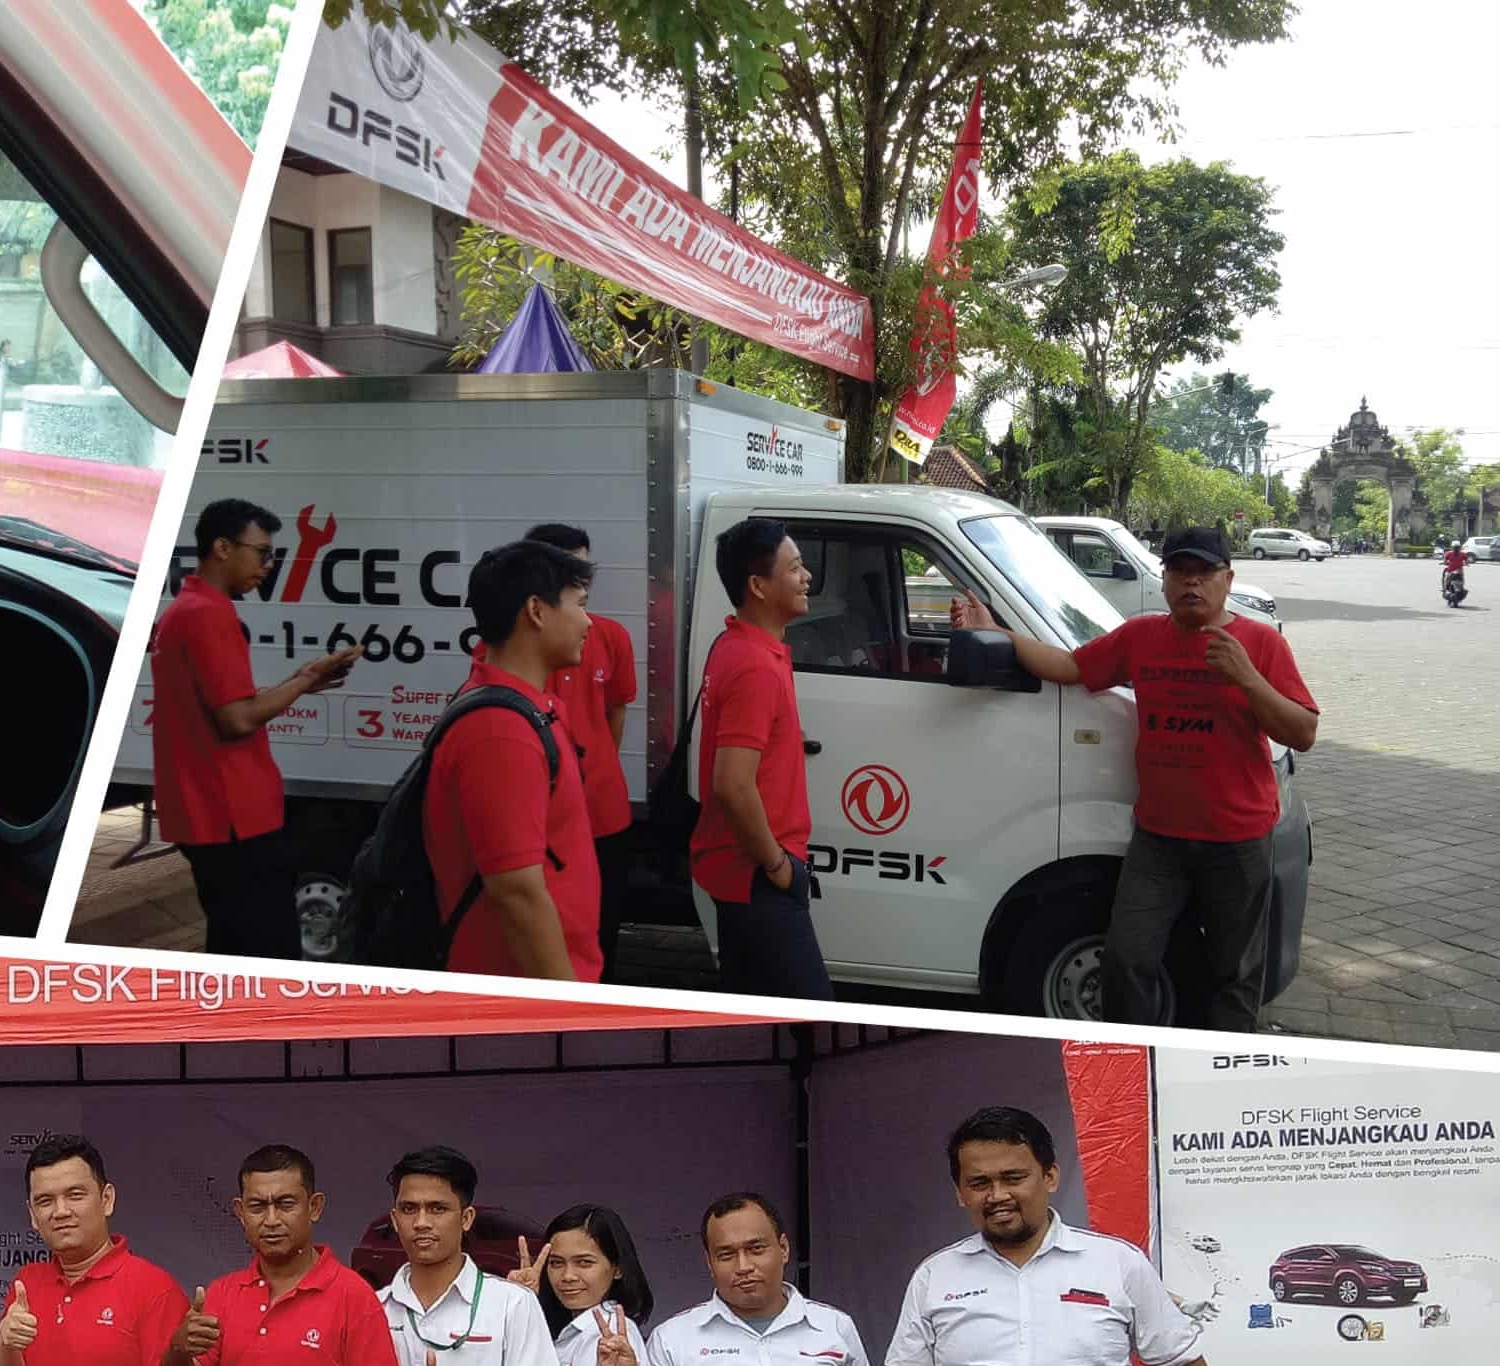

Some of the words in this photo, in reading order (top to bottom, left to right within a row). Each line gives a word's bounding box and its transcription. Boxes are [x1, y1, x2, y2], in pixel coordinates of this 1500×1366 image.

[327, 91, 446, 181] DFSK
[509, 97, 627, 211] KAMI
[618, 183, 691, 250] ADA
[688, 222, 829, 320] MENJANGKAU
[201, 438, 270, 463] FSK
[747, 424, 786, 457] SERVICE
[786, 441, 803, 461] CAR
[746, 456, 803, 477] 0800-1-666-999
[357, 710, 385, 738] 3
[807, 844, 947, 885] DFSK
[7, 964, 138, 1004] DFSK
[1241, 1109, 1294, 1125] DFSK
[1300, 1107, 1350, 1126] Flight
[1354, 1105, 1421, 1121] Service
[1172, 1131, 1225, 1152] KAMI
[1231, 1130, 1273, 1149] ADA
[1279, 1124, 1428, 1148] MENJANGKAU
[1435, 1120, 1495, 1141] ANDA
[1291, 1151, 1318, 1160] DFSK
[1321, 1150, 1347, 1160] Flight
[1350, 1149, 1383, 1158] Service
[1360, 1159, 1392, 1168] Hemat
